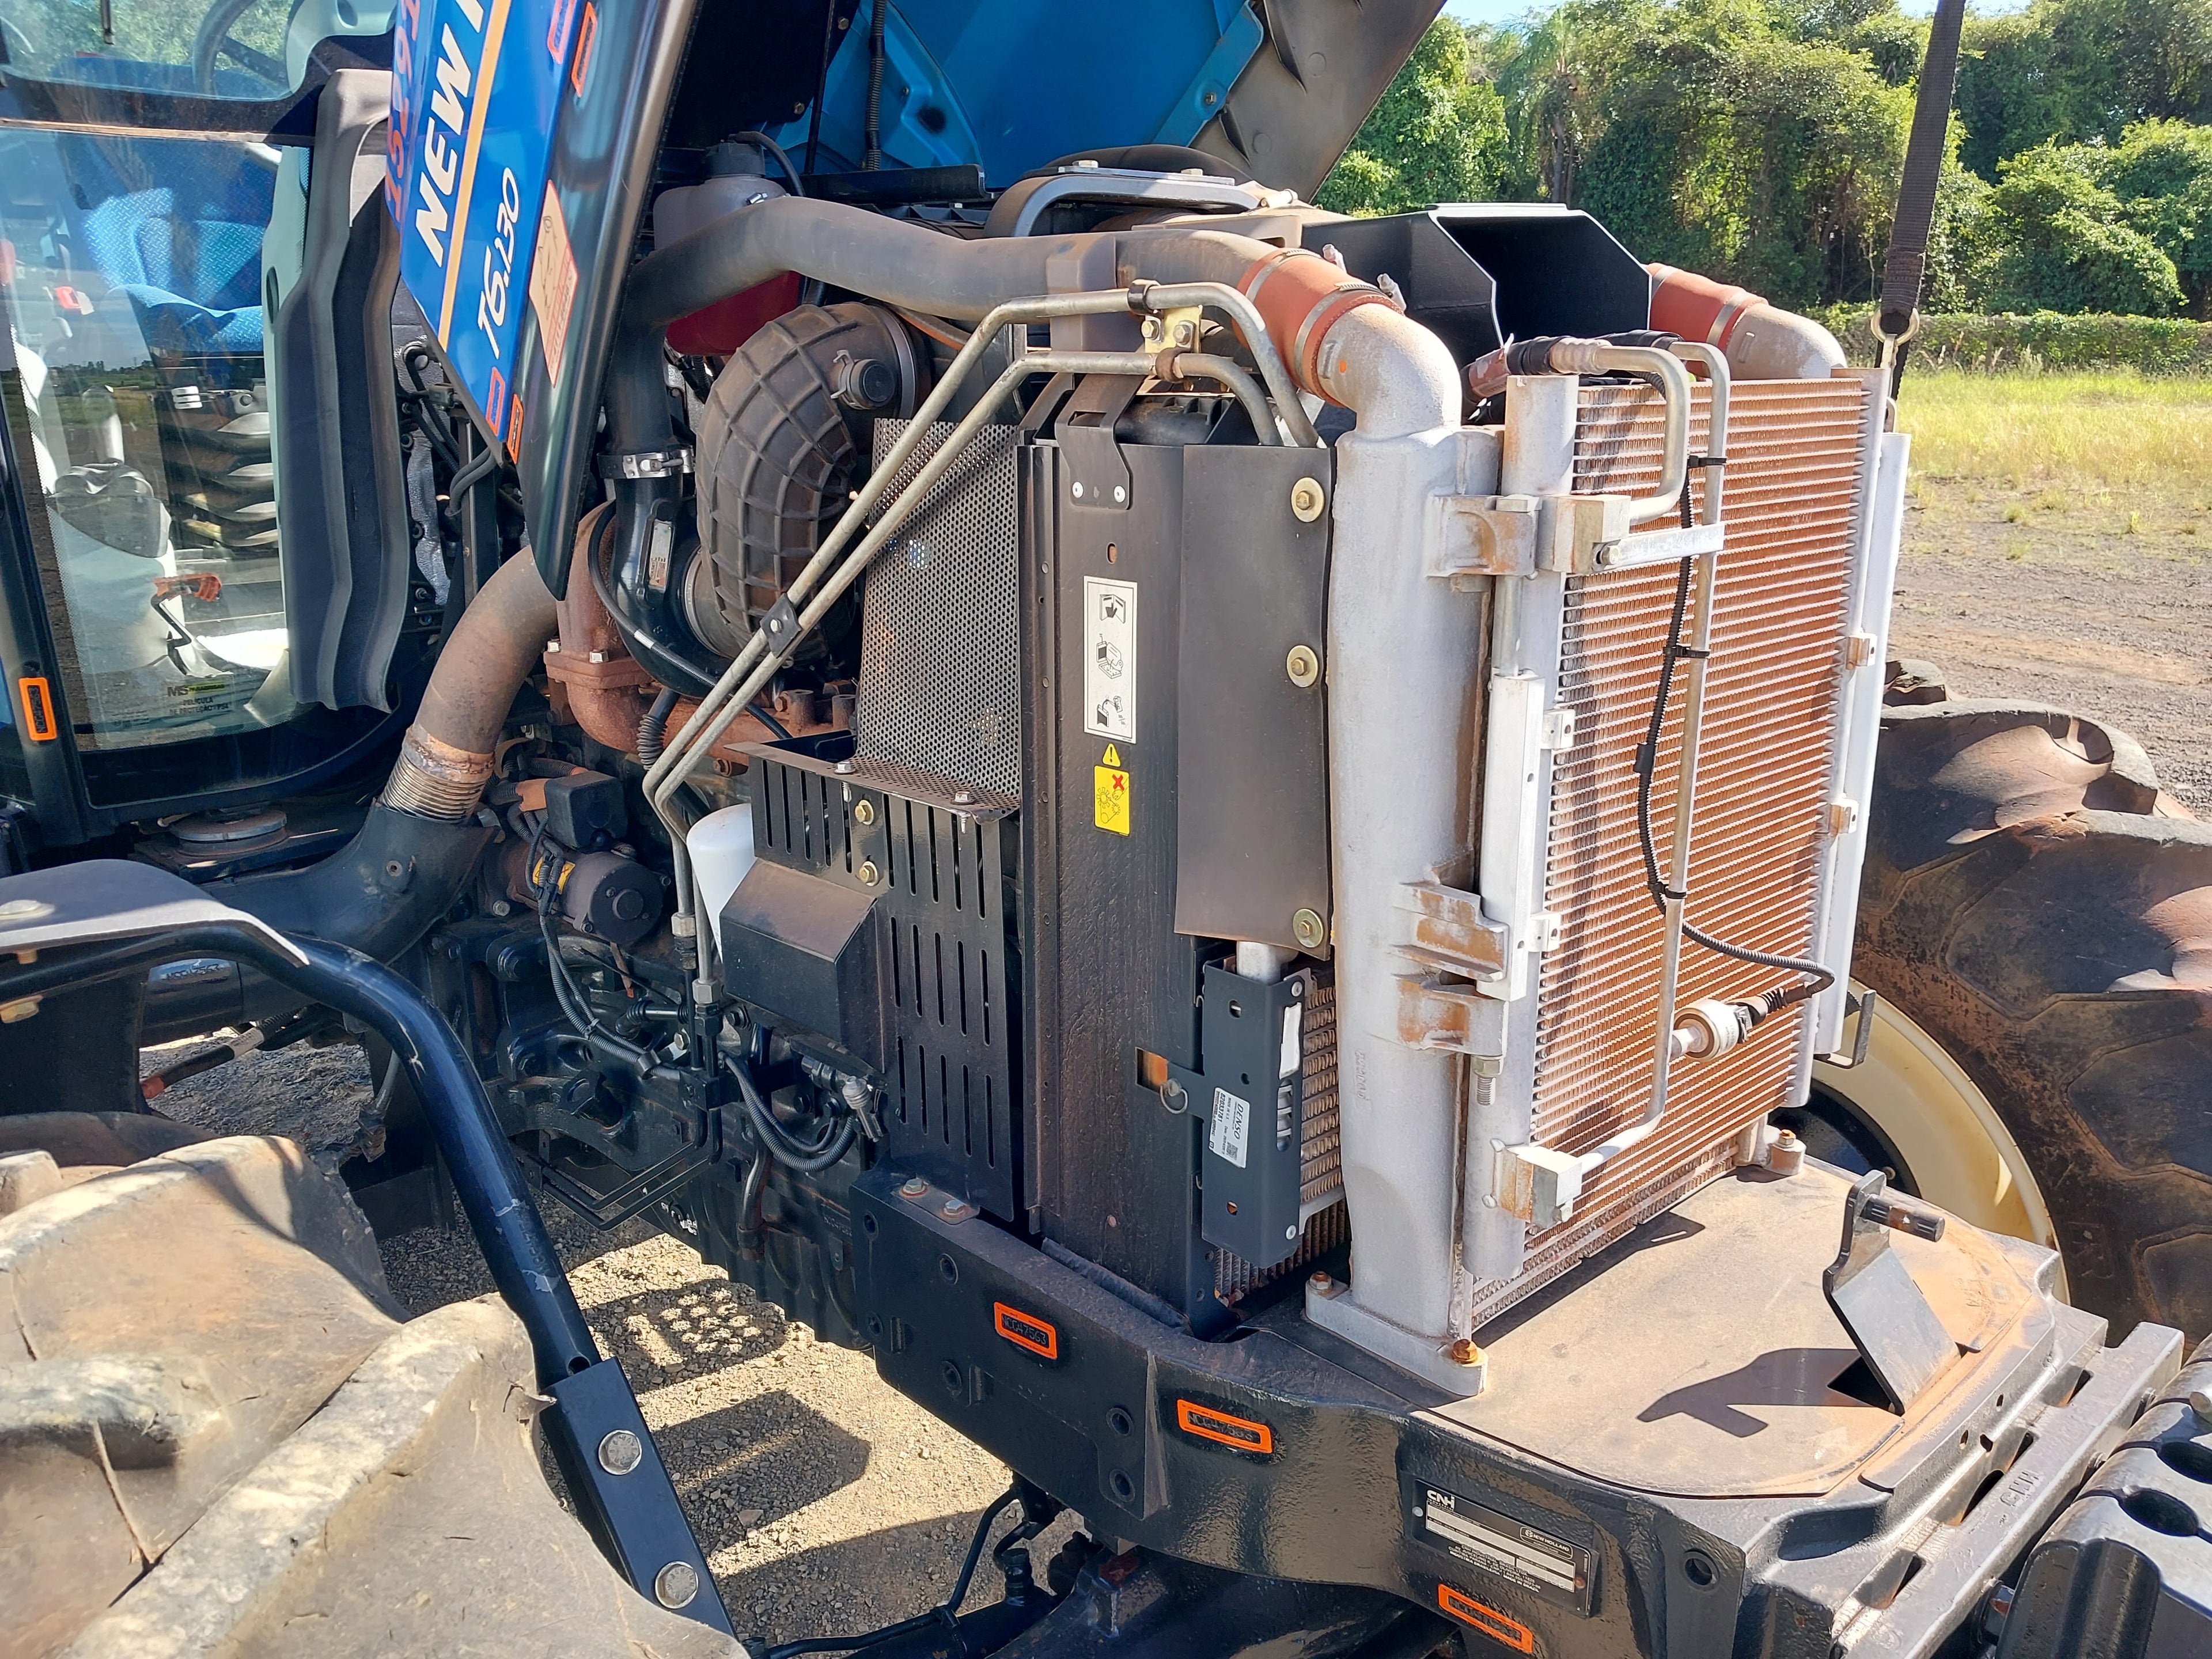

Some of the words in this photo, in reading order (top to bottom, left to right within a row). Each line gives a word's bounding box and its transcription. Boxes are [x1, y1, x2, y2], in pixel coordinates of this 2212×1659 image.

[415, 22, 471, 267] NEW
[478, 167, 519, 359] T6.130
[1234, 1103, 1244, 1140] DENSO
[1544, 1538, 1569, 1552] HOLLAND
